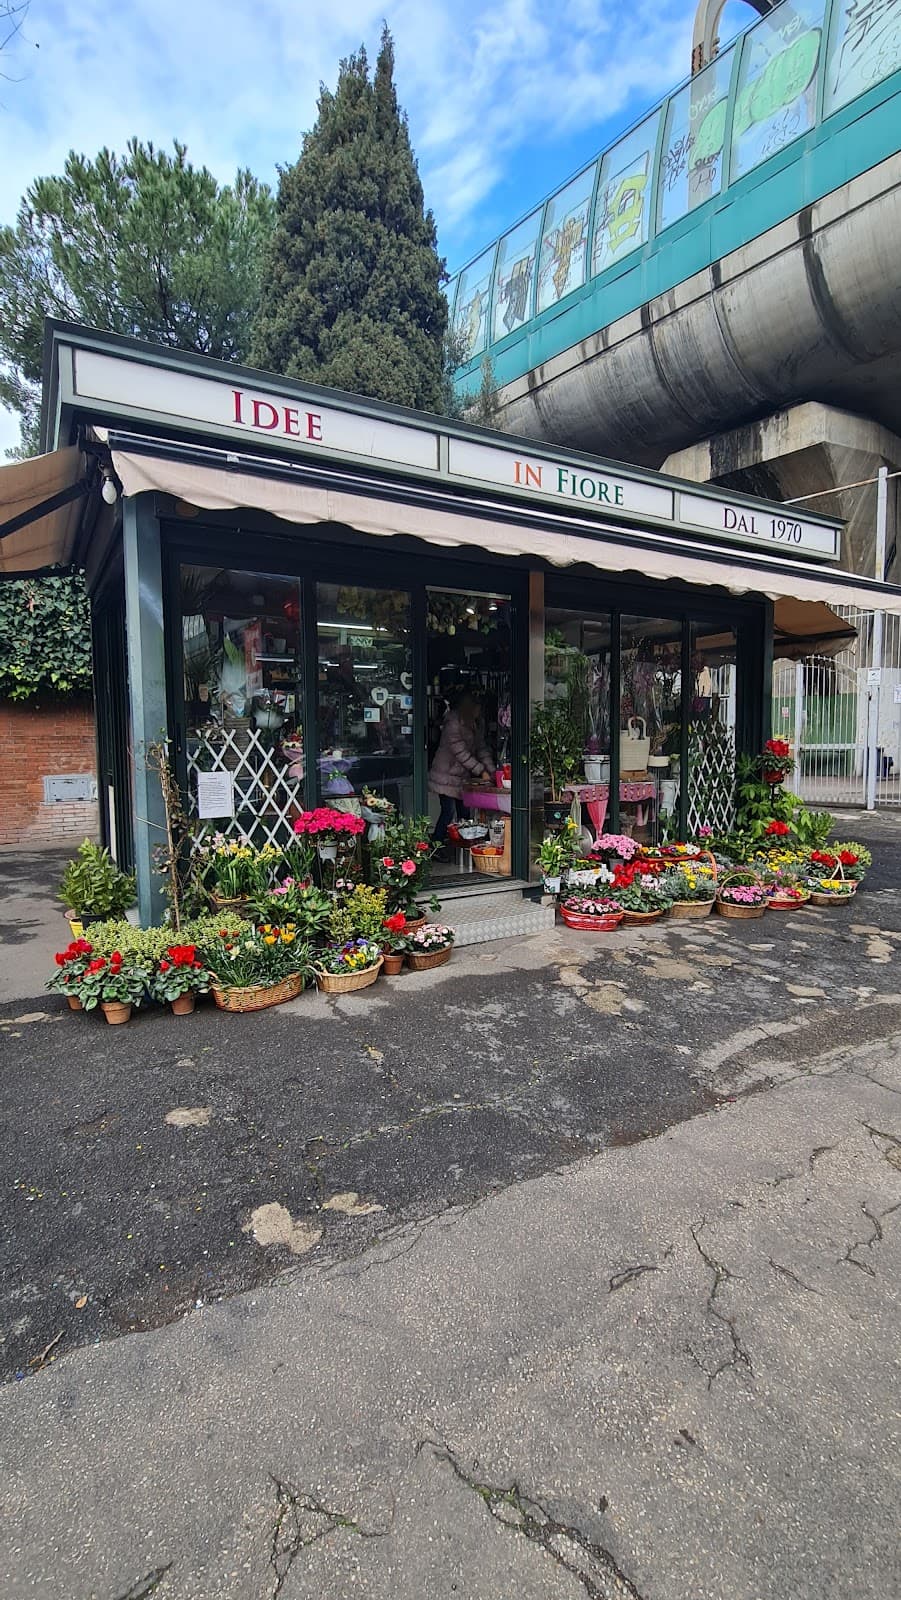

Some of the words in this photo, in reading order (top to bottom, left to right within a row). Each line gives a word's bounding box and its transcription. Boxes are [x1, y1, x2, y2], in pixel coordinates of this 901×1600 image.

[231, 390, 322, 441] IDEE
[514, 460, 543, 488] IN
[557, 467, 625, 505] FIORE
[724, 508, 759, 534] DAL
[770, 519, 802, 544] 1970
